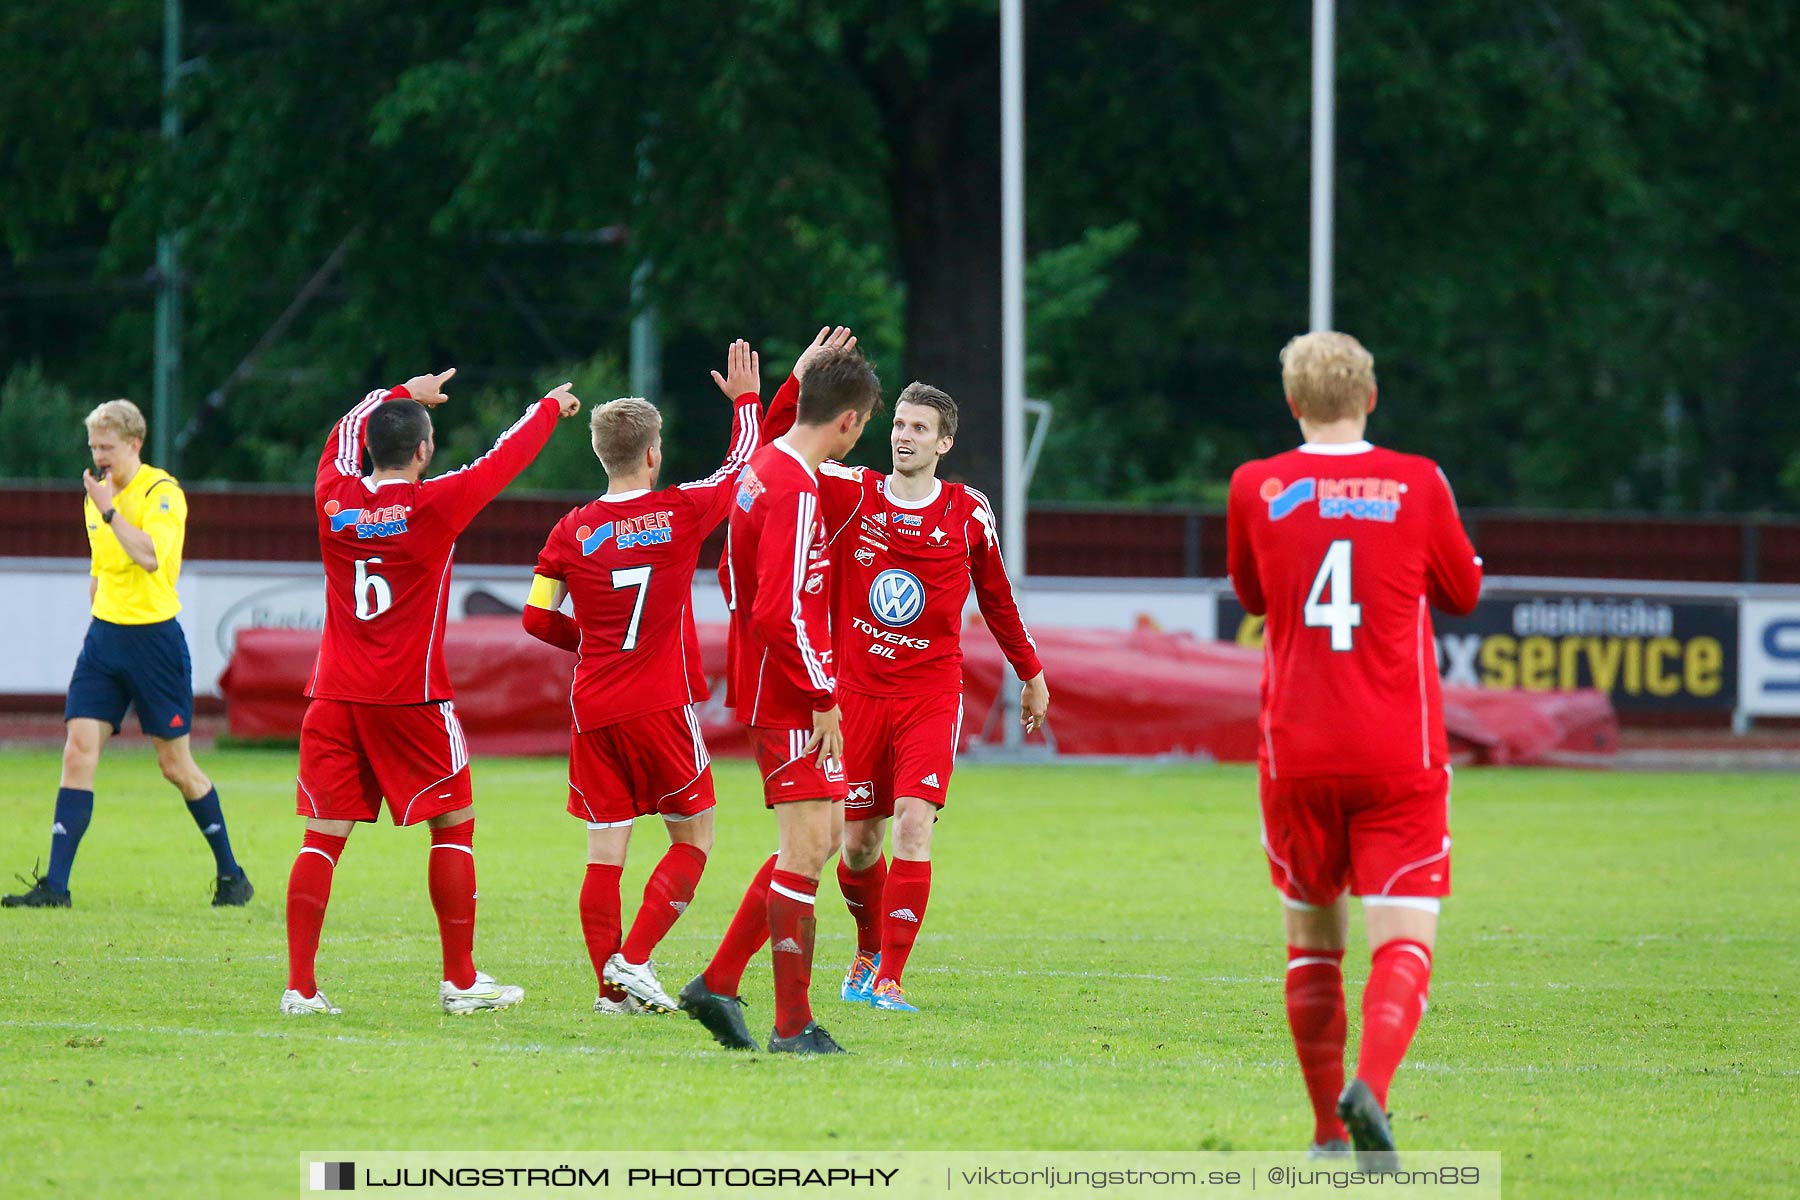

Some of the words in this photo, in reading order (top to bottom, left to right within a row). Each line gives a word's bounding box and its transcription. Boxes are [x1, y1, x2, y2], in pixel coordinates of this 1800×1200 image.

[1318, 478, 1401, 502] INTER
[1319, 498, 1401, 522] SPORT
[356, 519, 408, 538] SPORT
[615, 511, 670, 535] INTER
[616, 527, 672, 549] SPORT
[354, 556, 393, 621] 6
[1304, 539, 1361, 651] 4
[610, 564, 653, 651] 7
[852, 616, 930, 649] TOVEKS
[868, 643, 897, 660] BIL
